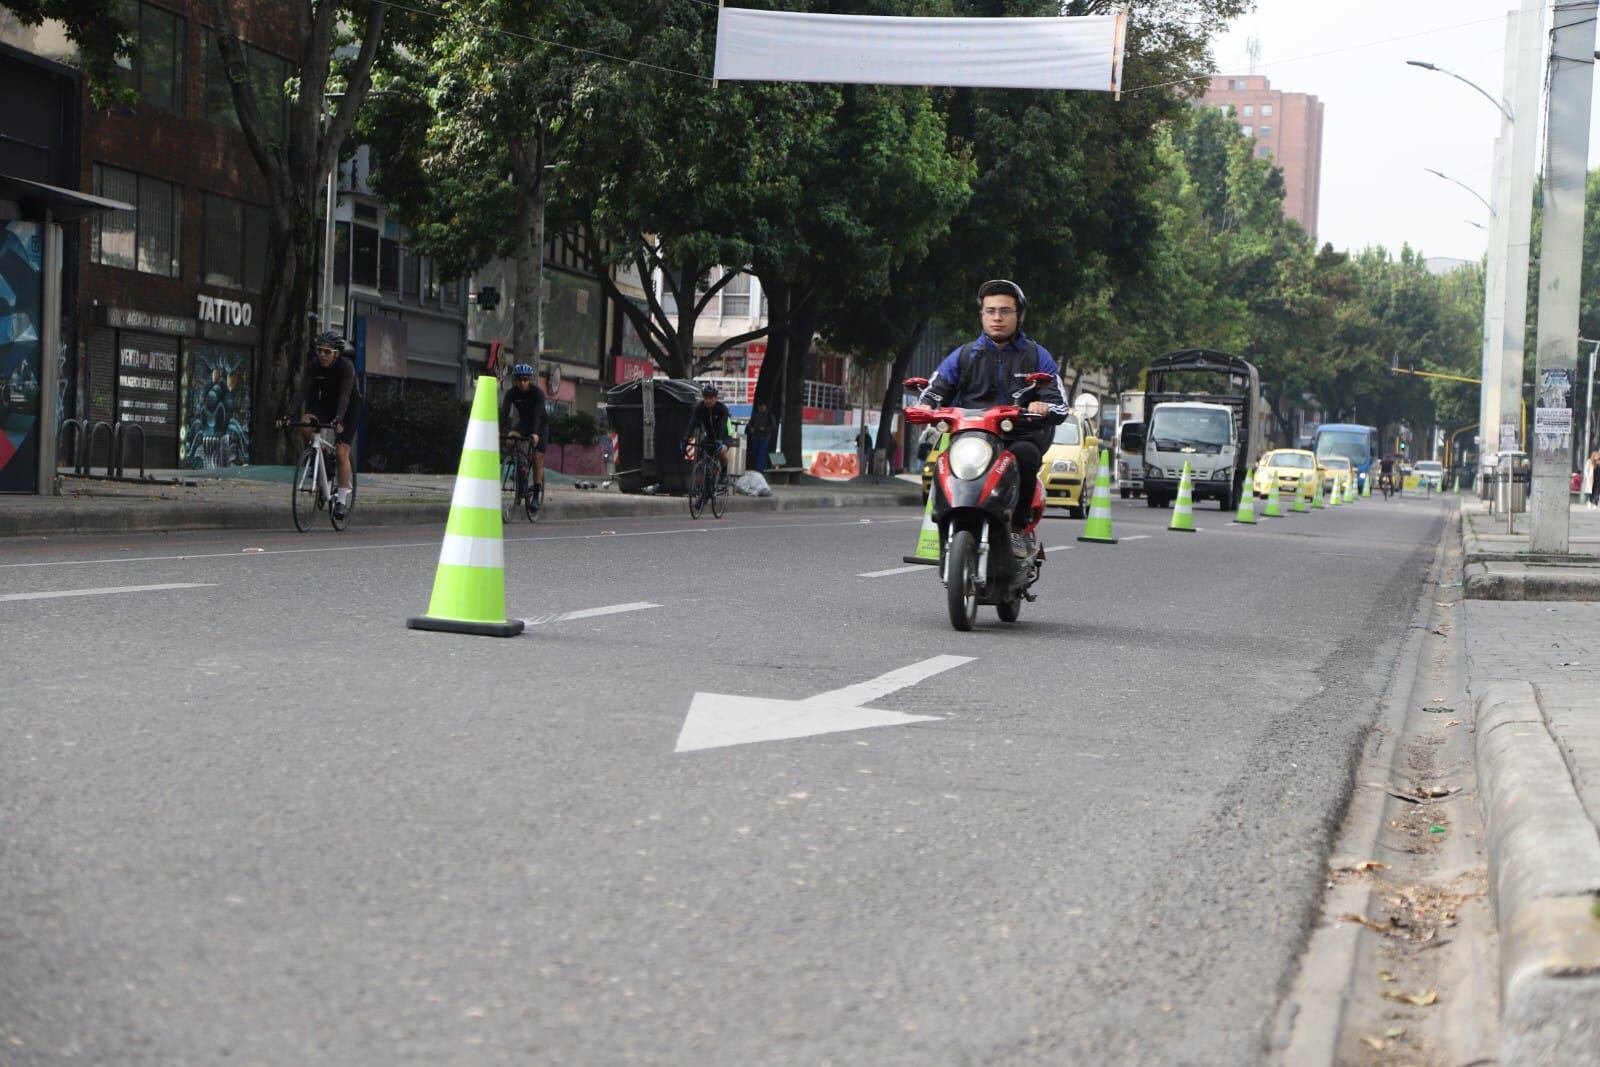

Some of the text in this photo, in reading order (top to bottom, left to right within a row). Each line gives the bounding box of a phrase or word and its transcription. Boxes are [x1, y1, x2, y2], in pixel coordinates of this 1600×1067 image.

[197, 294, 252, 327] TATTOO
[120, 348, 139, 368] VENTA
[149, 352, 178, 372] INTERNET
